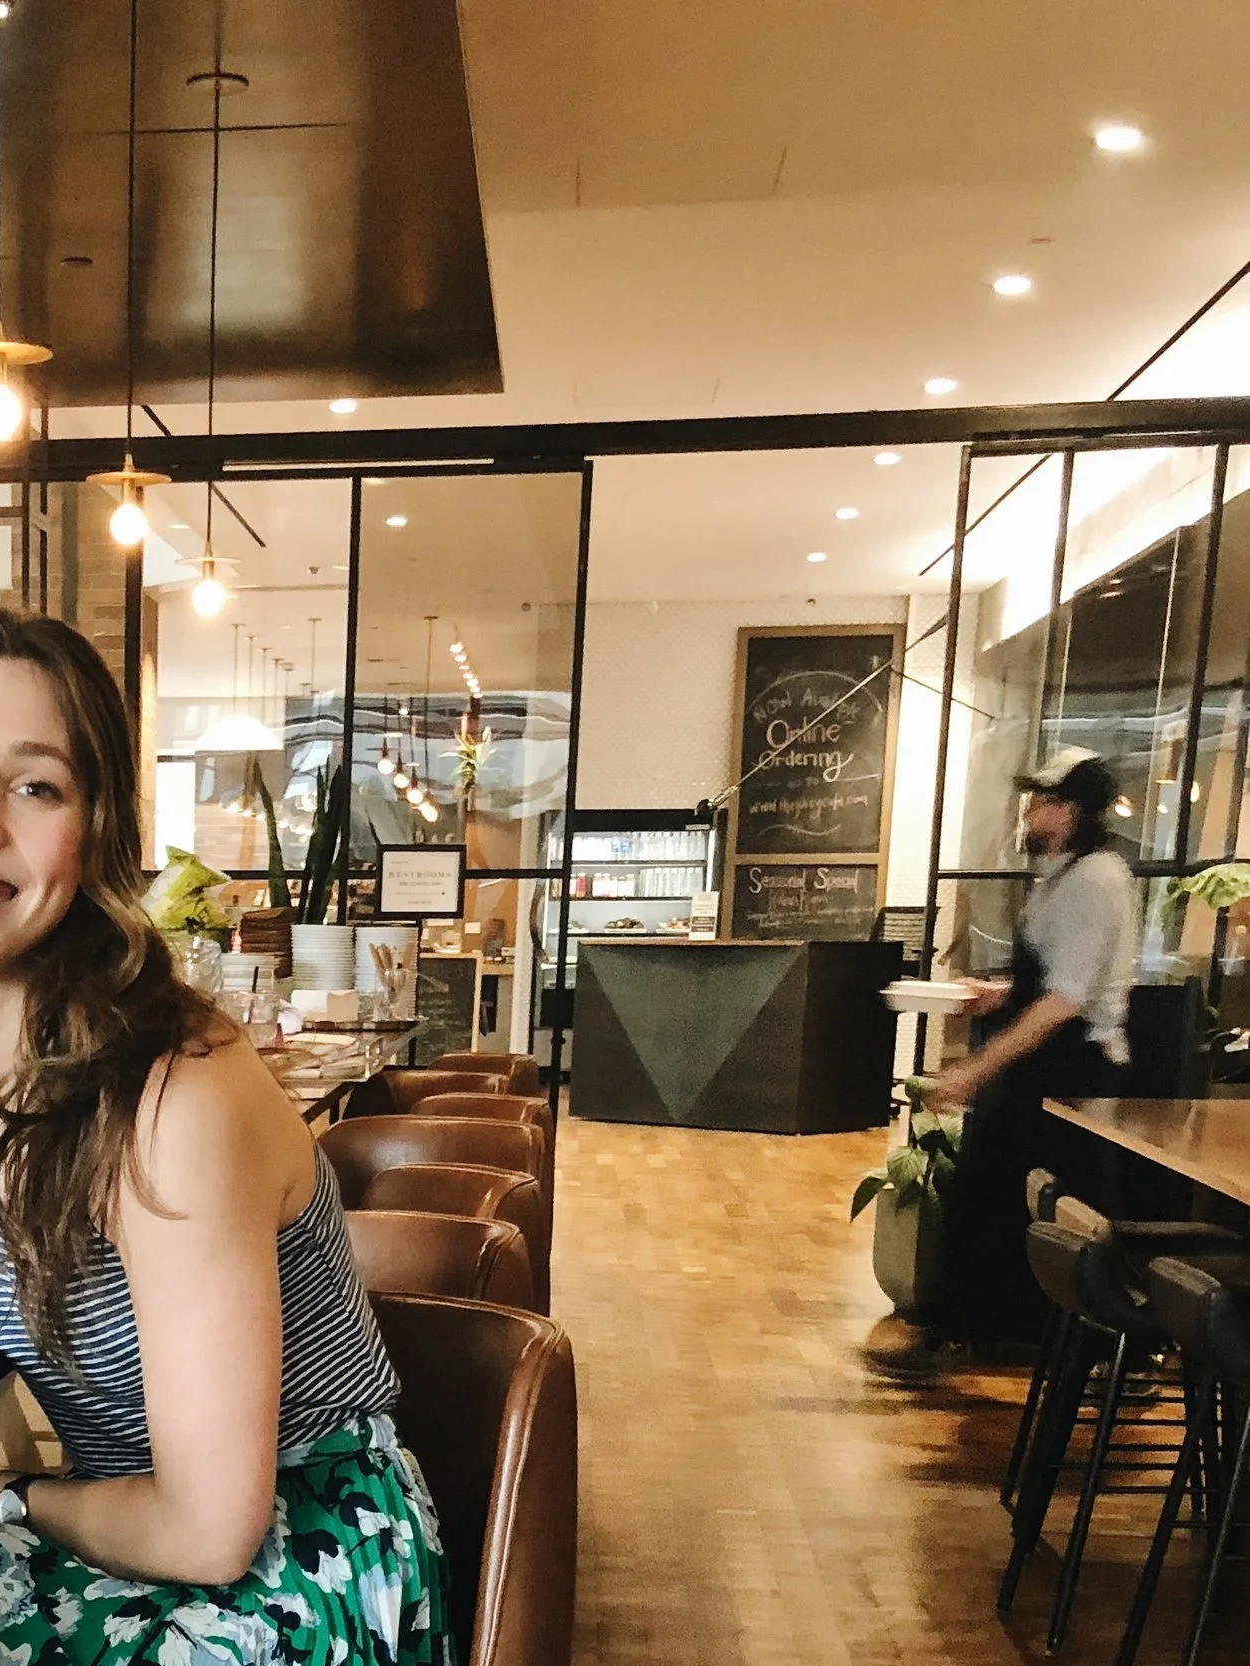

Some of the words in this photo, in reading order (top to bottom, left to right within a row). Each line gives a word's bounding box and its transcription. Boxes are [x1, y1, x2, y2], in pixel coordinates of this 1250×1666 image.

[766, 716, 841, 748] Online
[758, 751, 855, 782] Ordering
[388, 871, 452, 879] RESTROOMS
